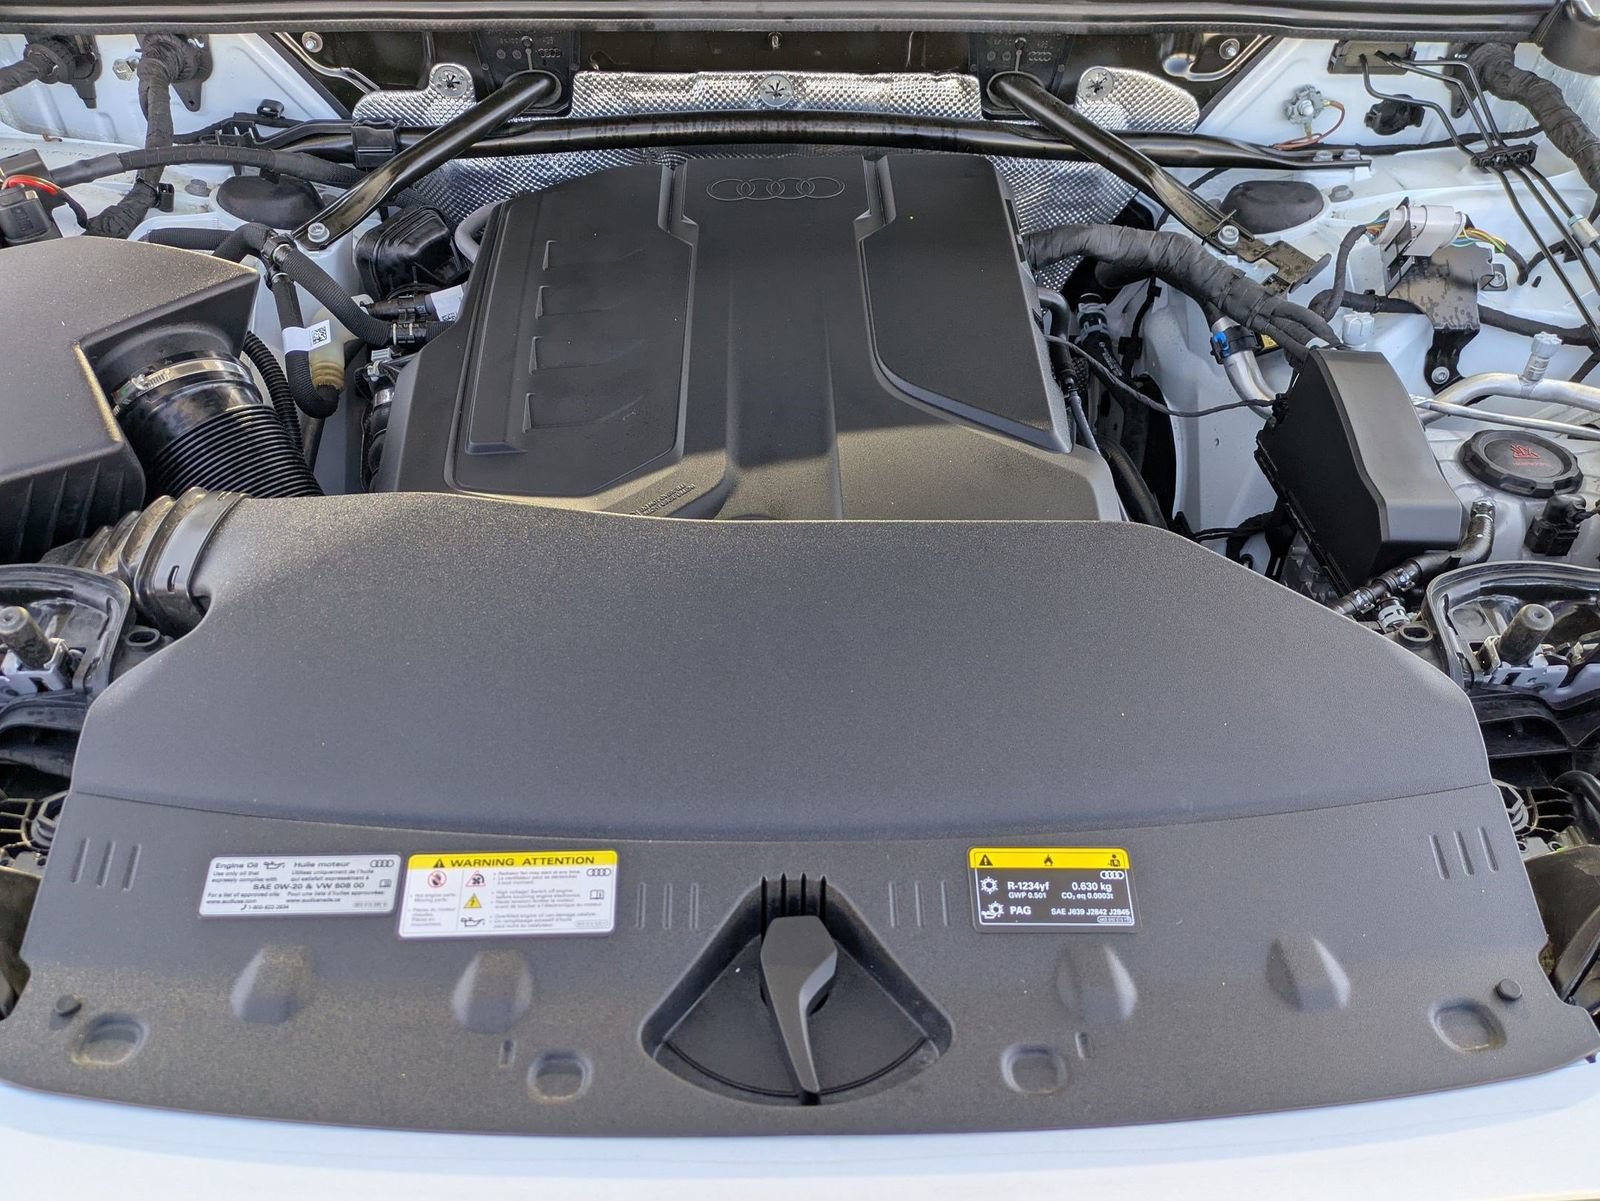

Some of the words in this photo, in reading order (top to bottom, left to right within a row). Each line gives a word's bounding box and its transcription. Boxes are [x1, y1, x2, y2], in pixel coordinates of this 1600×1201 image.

[450, 858, 514, 867] WARNING
[522, 857, 594, 866] ATTENTION
[1008, 881, 1049, 891] R-1234yf
[1072, 882, 1098, 890] 0.630
[1100, 882, 1112, 892] kg
[1010, 906, 1032, 915] PAG
